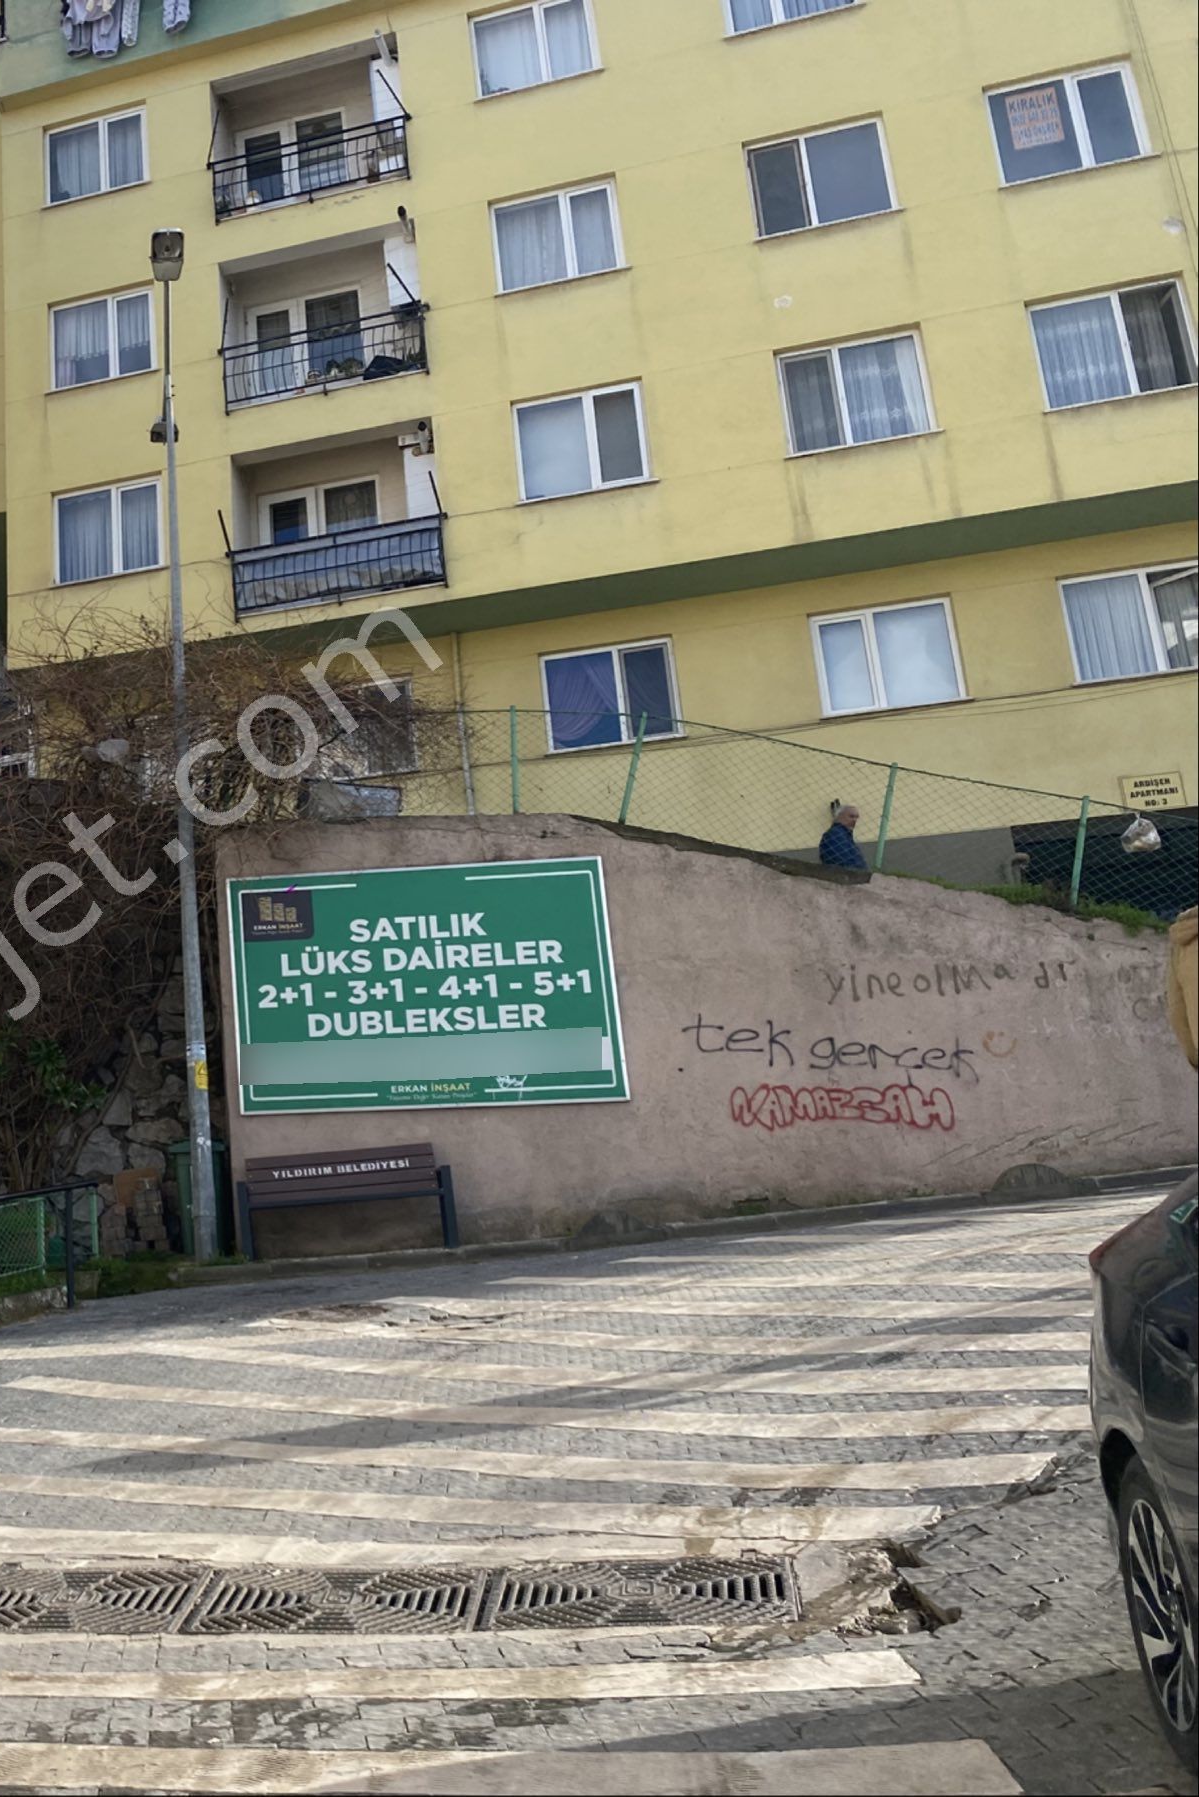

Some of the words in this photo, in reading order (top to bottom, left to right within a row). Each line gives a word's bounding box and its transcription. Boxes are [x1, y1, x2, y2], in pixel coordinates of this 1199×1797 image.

[1130, 787, 1178, 798] APARTMANI
[349, 912, 486, 943] SATILIK
[280, 946, 372, 978] LÜKS
[383, 939, 563, 972] DAİRELER
[258, 982, 314, 1009] 2+1
[348, 978, 404, 1005] 3+1
[438, 974, 499, 1000] 4+1
[534, 969, 592, 996] 5+1
[307, 1004, 546, 1038] DUBLEKSLER
[682, 1013, 795, 1068] tek
[390, 1085, 428, 1094] ERKAN
[431, 1082, 471, 1093] İNŞAAT
[272, 1166, 332, 1179] YILDIRIM
[337, 1158, 410, 1174] BELEDİYESİ
